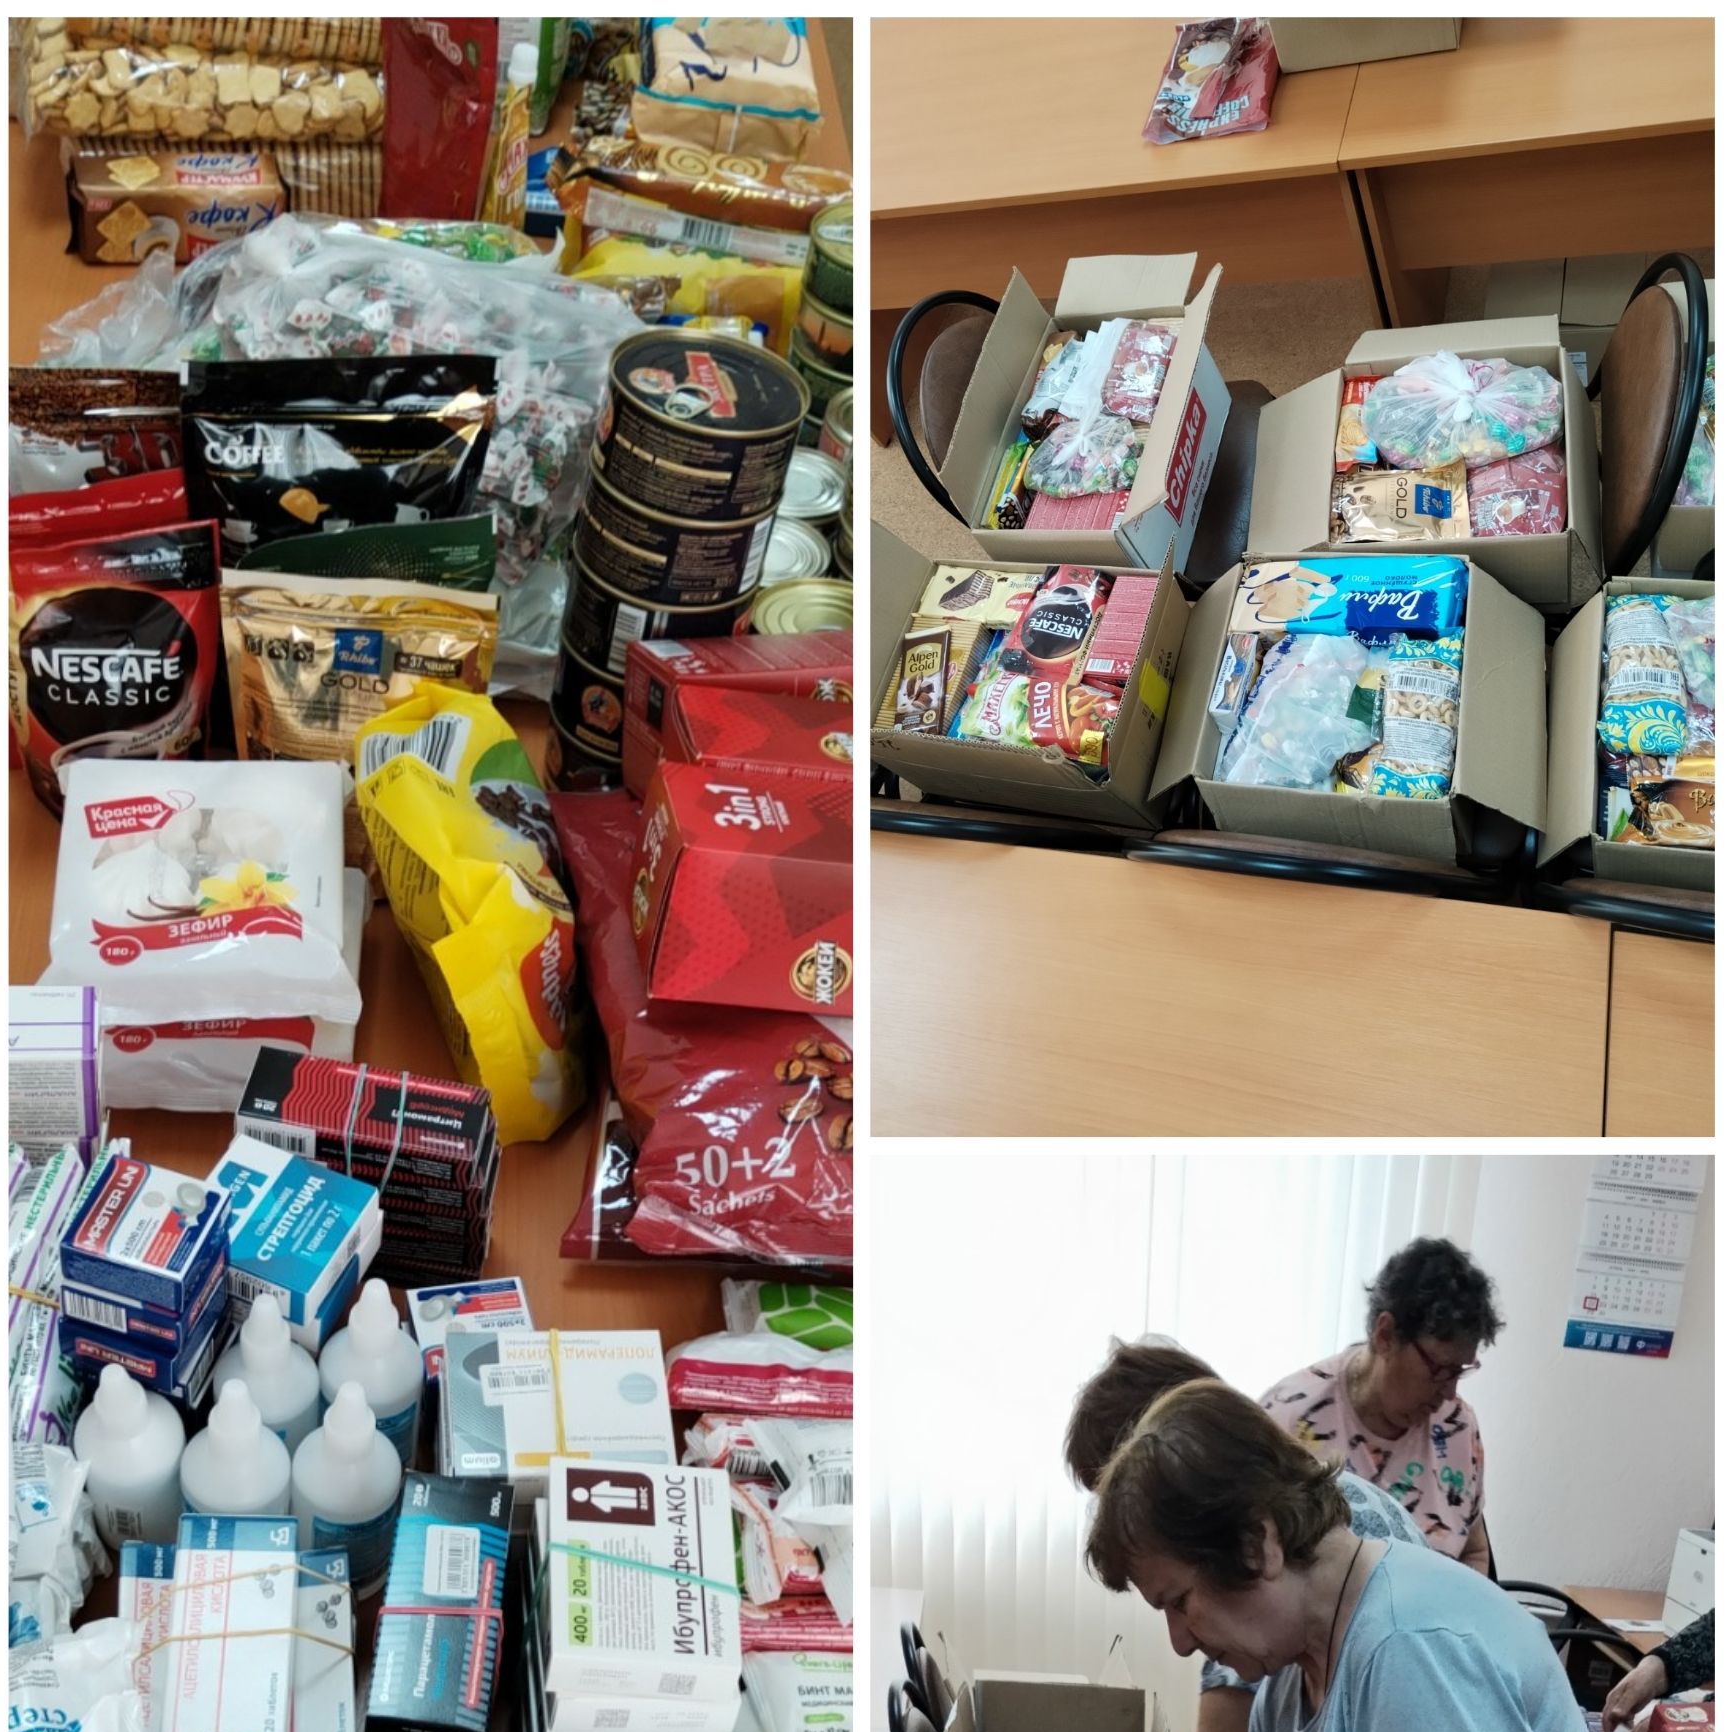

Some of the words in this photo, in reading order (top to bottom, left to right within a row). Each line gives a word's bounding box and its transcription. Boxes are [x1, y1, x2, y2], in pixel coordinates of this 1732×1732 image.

[1170, 402, 1201, 508] Chipka
[1395, 477, 1408, 519] GOLD
[1340, 587, 1424, 621] Вафли
[1036, 609, 1083, 626] CLASSIC
[409, 655, 422, 670] 37
[908, 651, 939, 665] Alpen
[909, 660, 936, 674] Gold
[47, 683, 171, 707] CLASSIC
[320, 672, 390, 696] GOLD
[1034, 681, 1053, 729] ЛЕЧО
[90, 801, 163, 822] Красная
[94, 817, 138, 834] цена
[168, 914, 233, 938] ЗЕФИР
[106, 946, 128, 957] 180
[84, 1188, 126, 1248] MASTER
[257, 1176, 327, 1261] СТРЕПТОЦИД
[574, 1615, 589, 1643] 400
[798, 1685, 831, 1697] БИНТ
